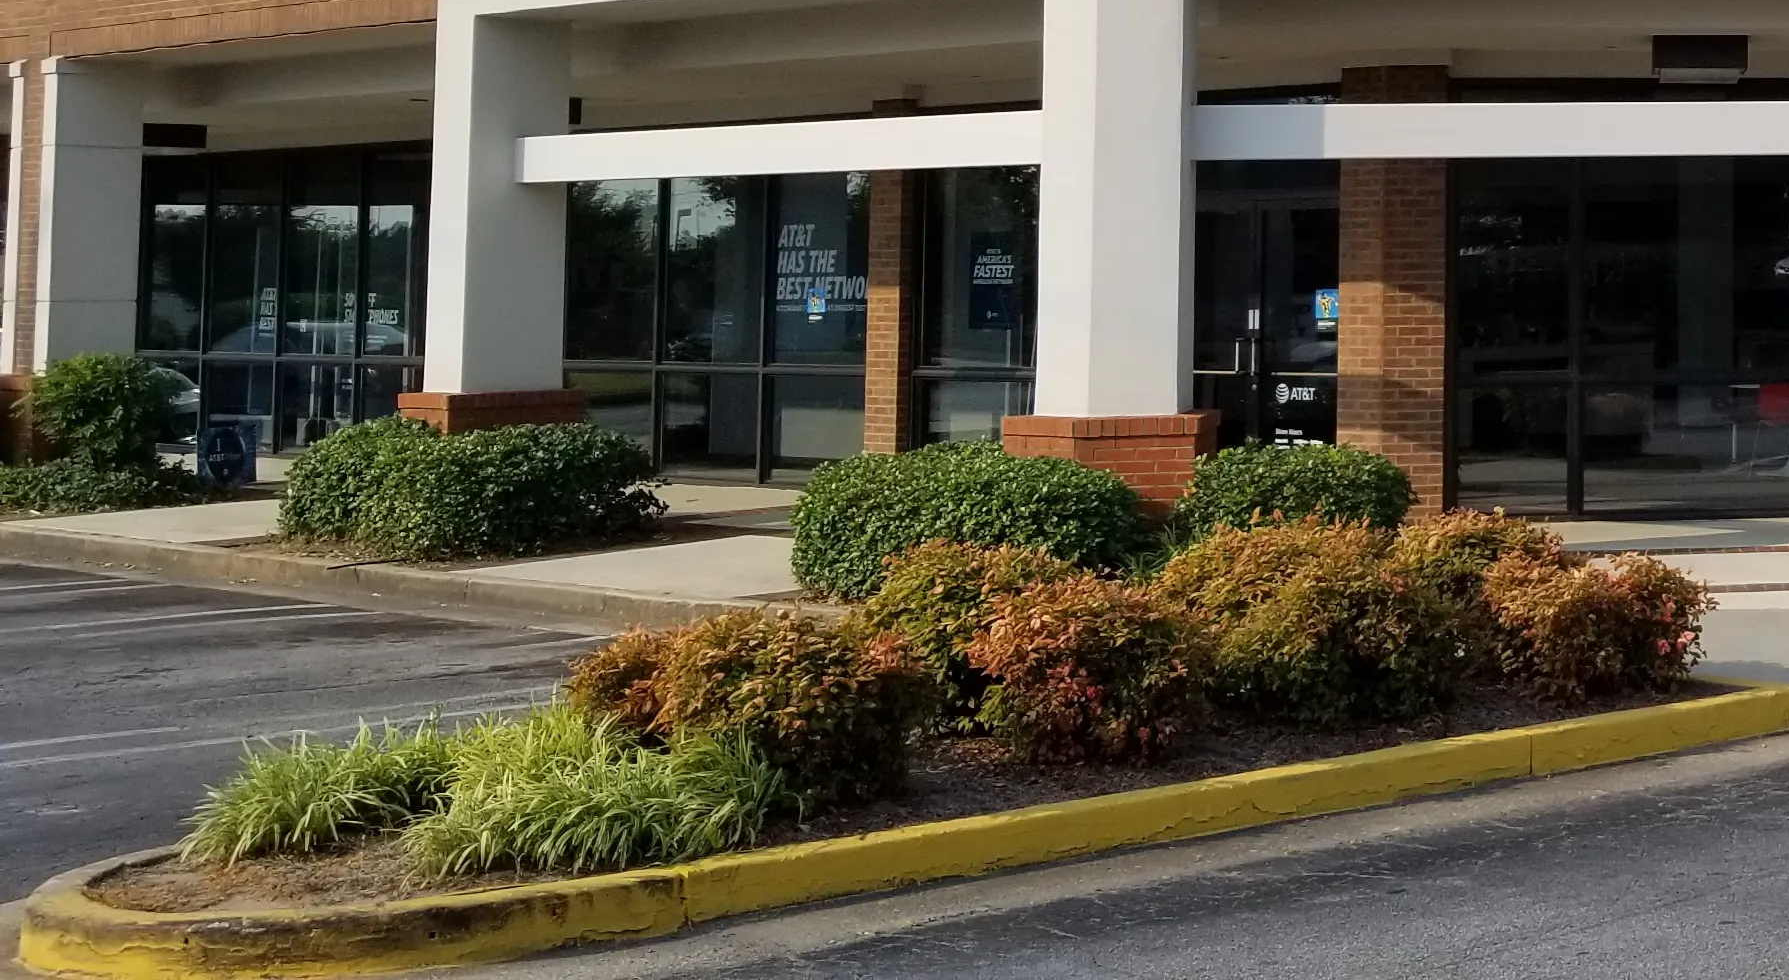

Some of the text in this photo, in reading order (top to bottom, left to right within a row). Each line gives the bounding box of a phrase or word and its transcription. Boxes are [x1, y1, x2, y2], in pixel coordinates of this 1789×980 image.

[778, 224, 815, 248] AT&T
[777, 250, 837, 273] HAS THE
[976, 255, 1012, 264] AMERICA'S
[973, 265, 1015, 278] FASTEST
[776, 276, 868, 300] BEST NETWO
[1290, 387, 1316, 400] AT&T
